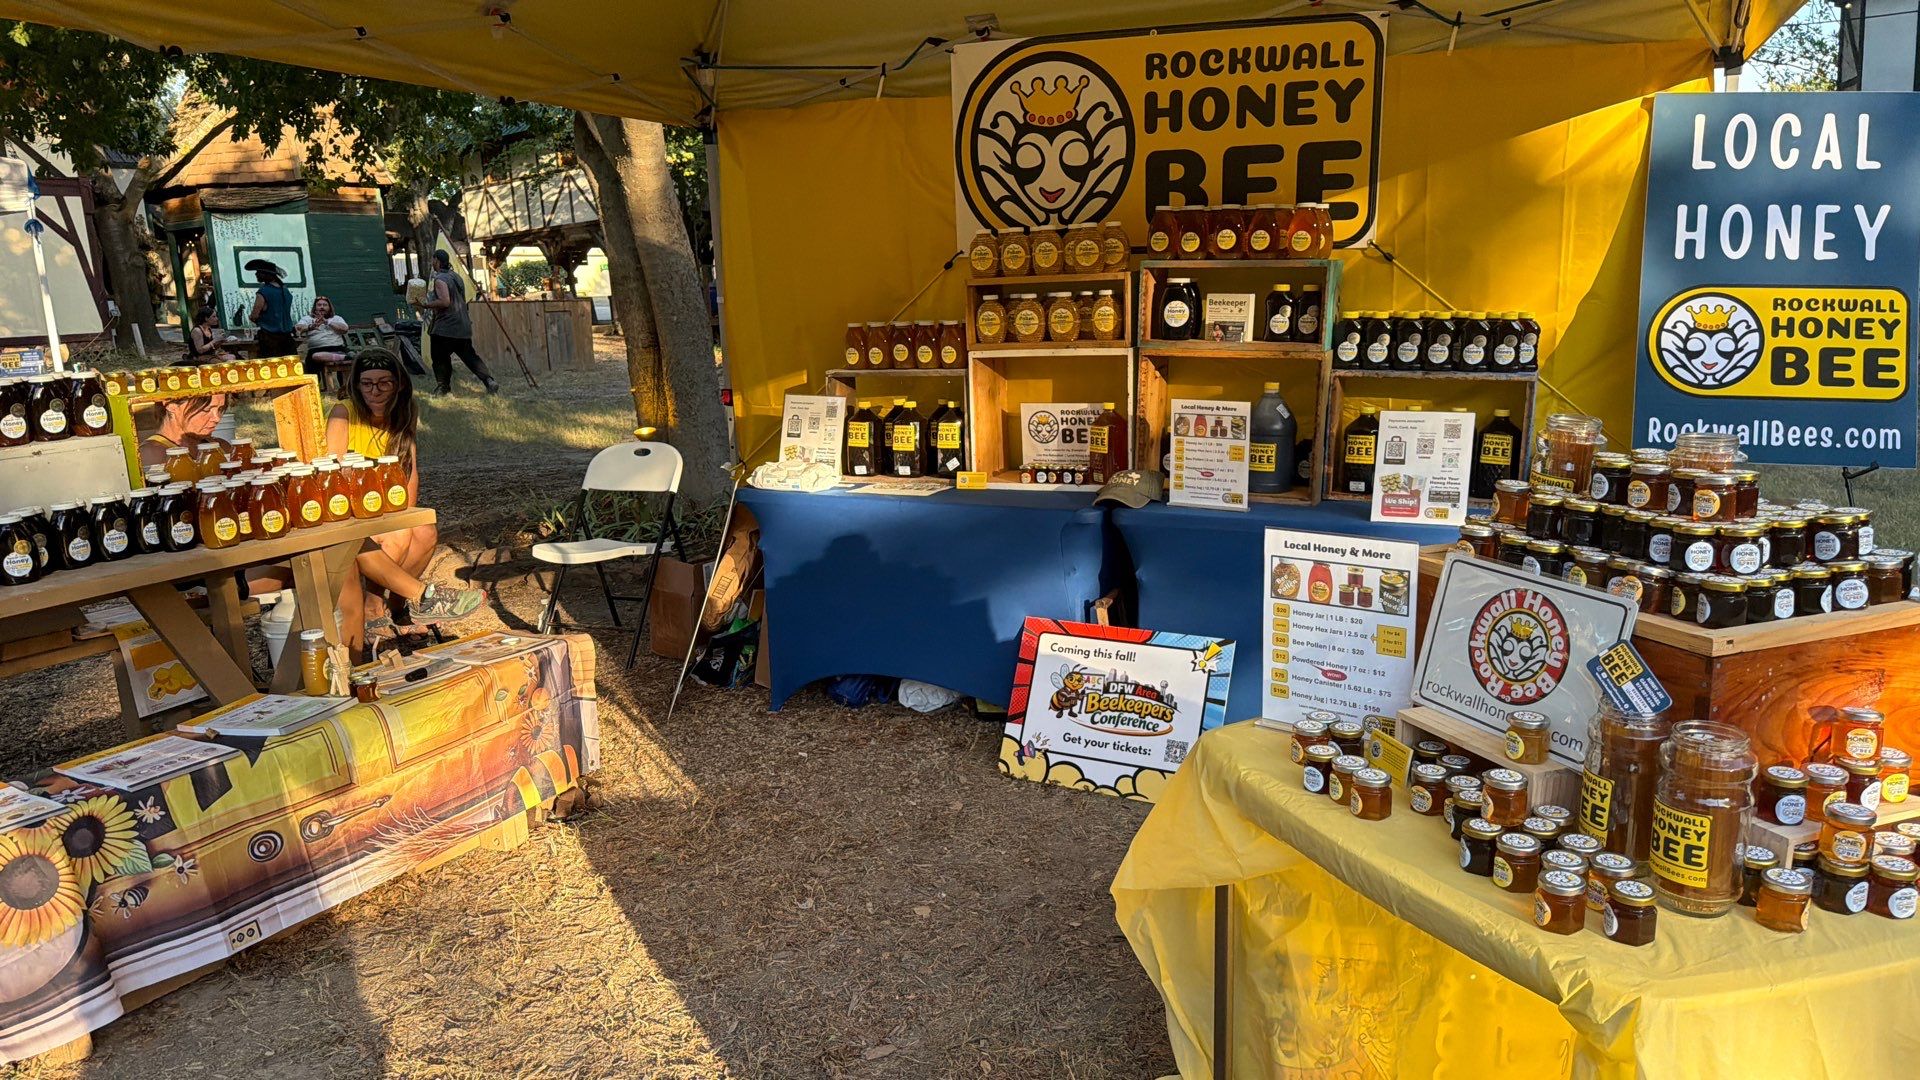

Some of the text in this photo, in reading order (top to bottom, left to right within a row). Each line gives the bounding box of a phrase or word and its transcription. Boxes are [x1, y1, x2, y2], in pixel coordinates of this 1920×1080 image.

[1145, 40, 1365, 80] ROCKWALL
[1144, 77, 1365, 135] HONEY
[1692, 113, 1882, 170] LOCAL
[1674, 204, 1891, 261] HONEY
[1208, 298, 1247, 308] Beekeeper
[1772, 297, 1901, 313] ROCKWALL
[1770, 316, 1901, 340] HONEY
[1770, 346, 1901, 388] BEE
[848, 432, 867, 440] BEE
[894, 435, 913, 444] BEE
[938, 433, 957, 442] BEE
[1090, 436, 1106, 447] BEE
[1250, 454, 1274, 464] BEE
[1348, 446, 1373, 455] BEE
[1482, 446, 1510, 457] BEE
[1398, 498, 1418, 506] Ship!
[1284, 540, 1392, 560] Local Honey & More
[1277, 578, 1298, 595] Pollen
[1292, 609, 1314, 619] Honey
[1350, 617, 1363, 625] $20
[1292, 622, 1314, 631] Honey
[1315, 625, 1328, 633] Hex
[1329, 626, 1343, 635] Jars
[1360, 632, 1368, 640] oz
[1523, 589, 1565, 668] Honey
[1050, 642, 1137, 662] Coming this fall!
[1306, 641, 1328, 650] Pollen
[1351, 648, 1365, 656] $20
[1292, 655, 1325, 667] Powdered
[1325, 660, 1348, 672] Honey
[1373, 669, 1386, 677] $12
[1601, 653, 1630, 685] BEE
[1613, 648, 1637, 676] HONEY
[1108, 682, 1135, 693] DFW
[1136, 685, 1158, 699] Area
[1291, 674, 1313, 684] Honey
[1314, 678, 1342, 688] Canister
[1347, 684, 1362, 693] 5.62
[1085, 693, 1174, 722] Beekeepers
[1273, 687, 1287, 695] $150
[1291, 690, 1313, 701] Honey
[1313, 693, 1325, 704] Jug
[1329, 698, 1347, 707] 12.75
[1363, 704, 1381, 713] $150
[1090, 712, 1160, 732] Conference
[1062, 732, 1152, 756] Get your tickets:
[1847, 736, 1875, 744] HONEY
[1652, 826, 1705, 867] BEE
[1835, 837, 1865, 848] HONEY
